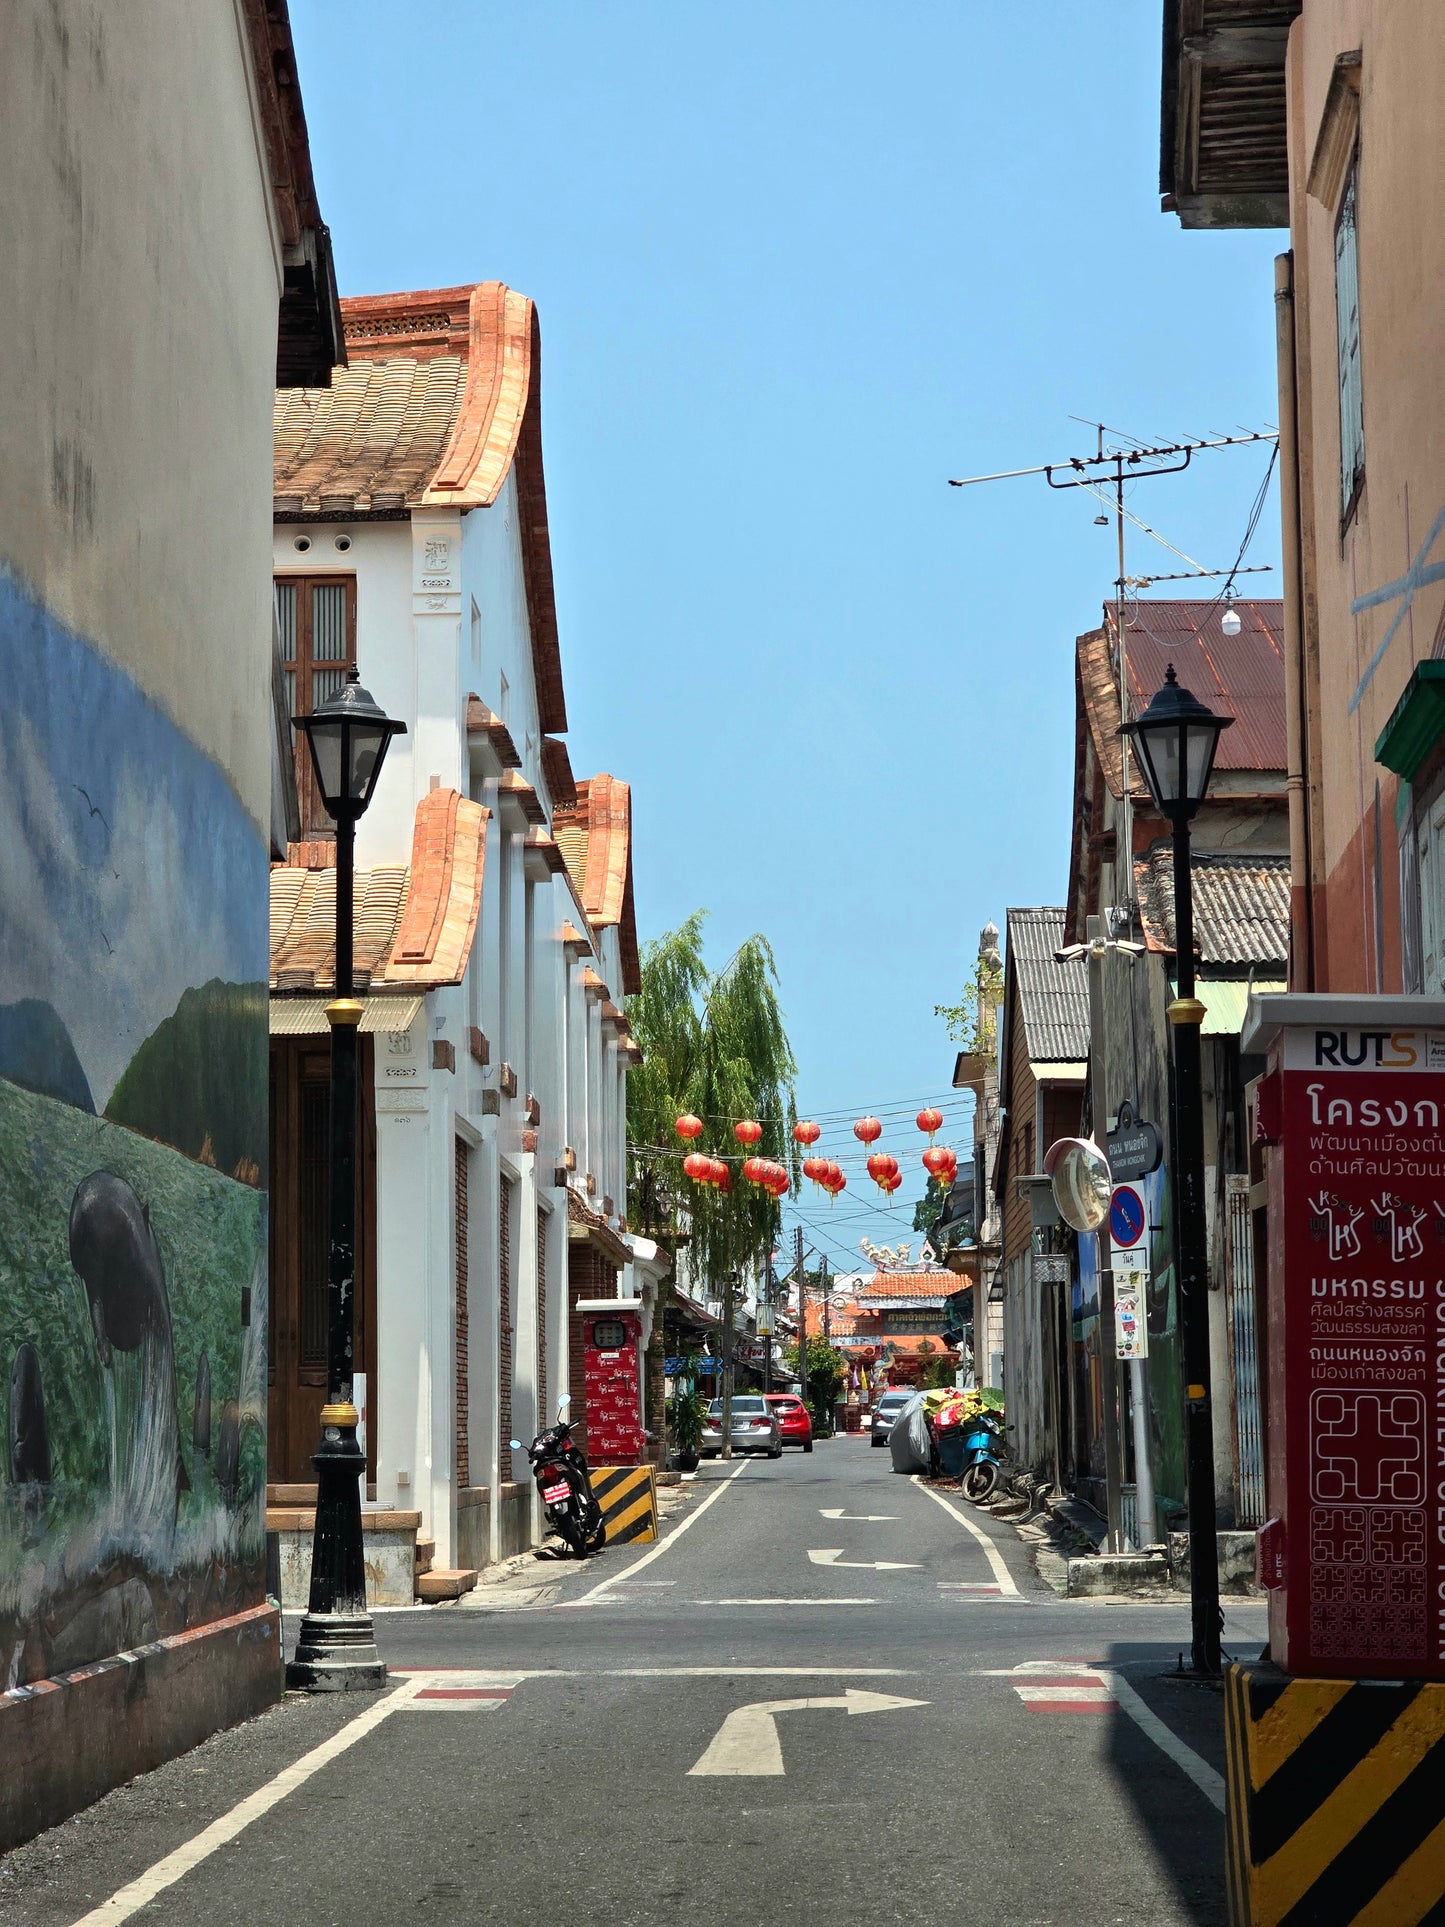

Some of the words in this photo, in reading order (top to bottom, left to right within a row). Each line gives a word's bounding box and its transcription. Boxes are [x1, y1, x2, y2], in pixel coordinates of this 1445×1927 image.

[1315, 1031, 1418, 1067] RUTS
[1306, 1083, 1445, 1127] โครงก
[1309, 1154, 1445, 1177] ด้านศิลปวัฒน
[1311, 1278, 1425, 1299] มหกรรม
[1311, 1300, 1429, 1319] ศิลป์สร้างสรรค์
[1311, 1318, 1425, 1335] วัฒนธรรมสงขลา
[1309, 1346, 1426, 1362] ถนนหนองจิก
[1311, 1362, 1426, 1381] เมืองเก่าสงขลา
